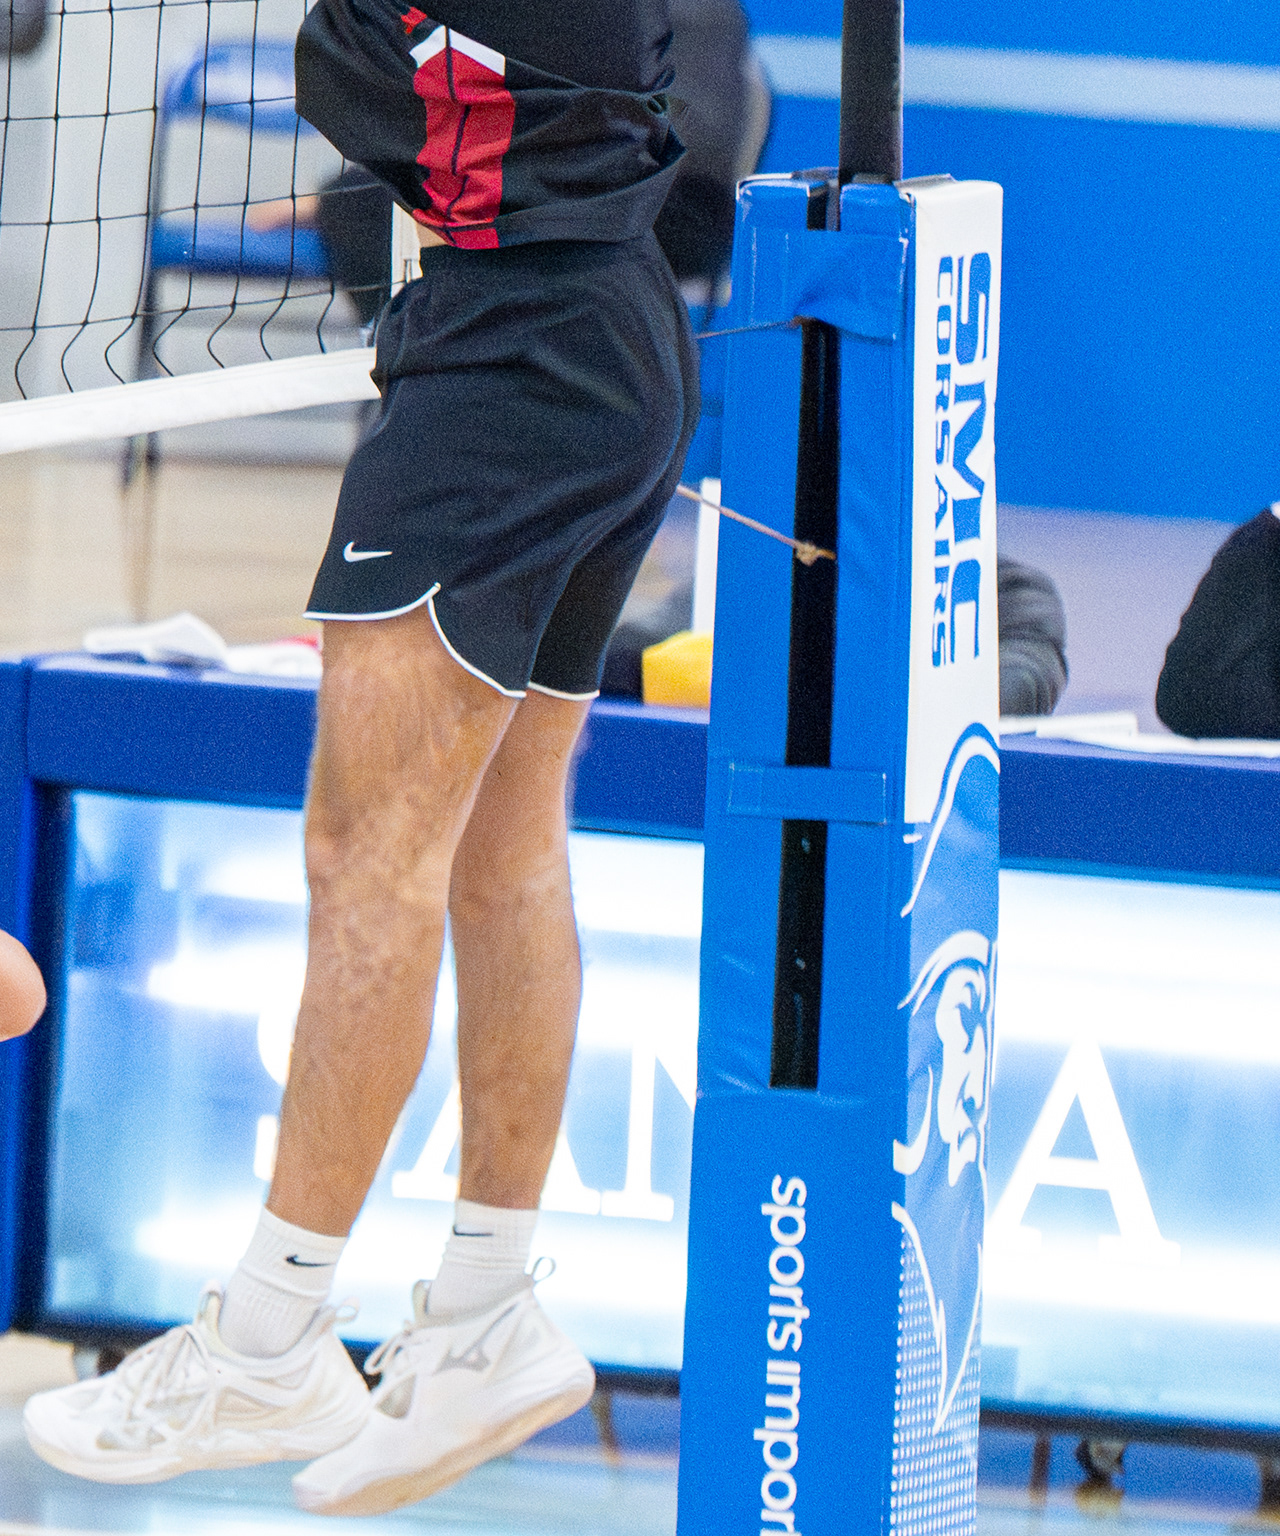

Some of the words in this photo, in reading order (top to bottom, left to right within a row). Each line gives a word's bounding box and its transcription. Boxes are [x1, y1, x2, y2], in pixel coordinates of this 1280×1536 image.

[931, 255, 953, 668] CORSAIRS
[949, 251, 991, 664] SMC
[760, 1175, 811, 1353] sports
